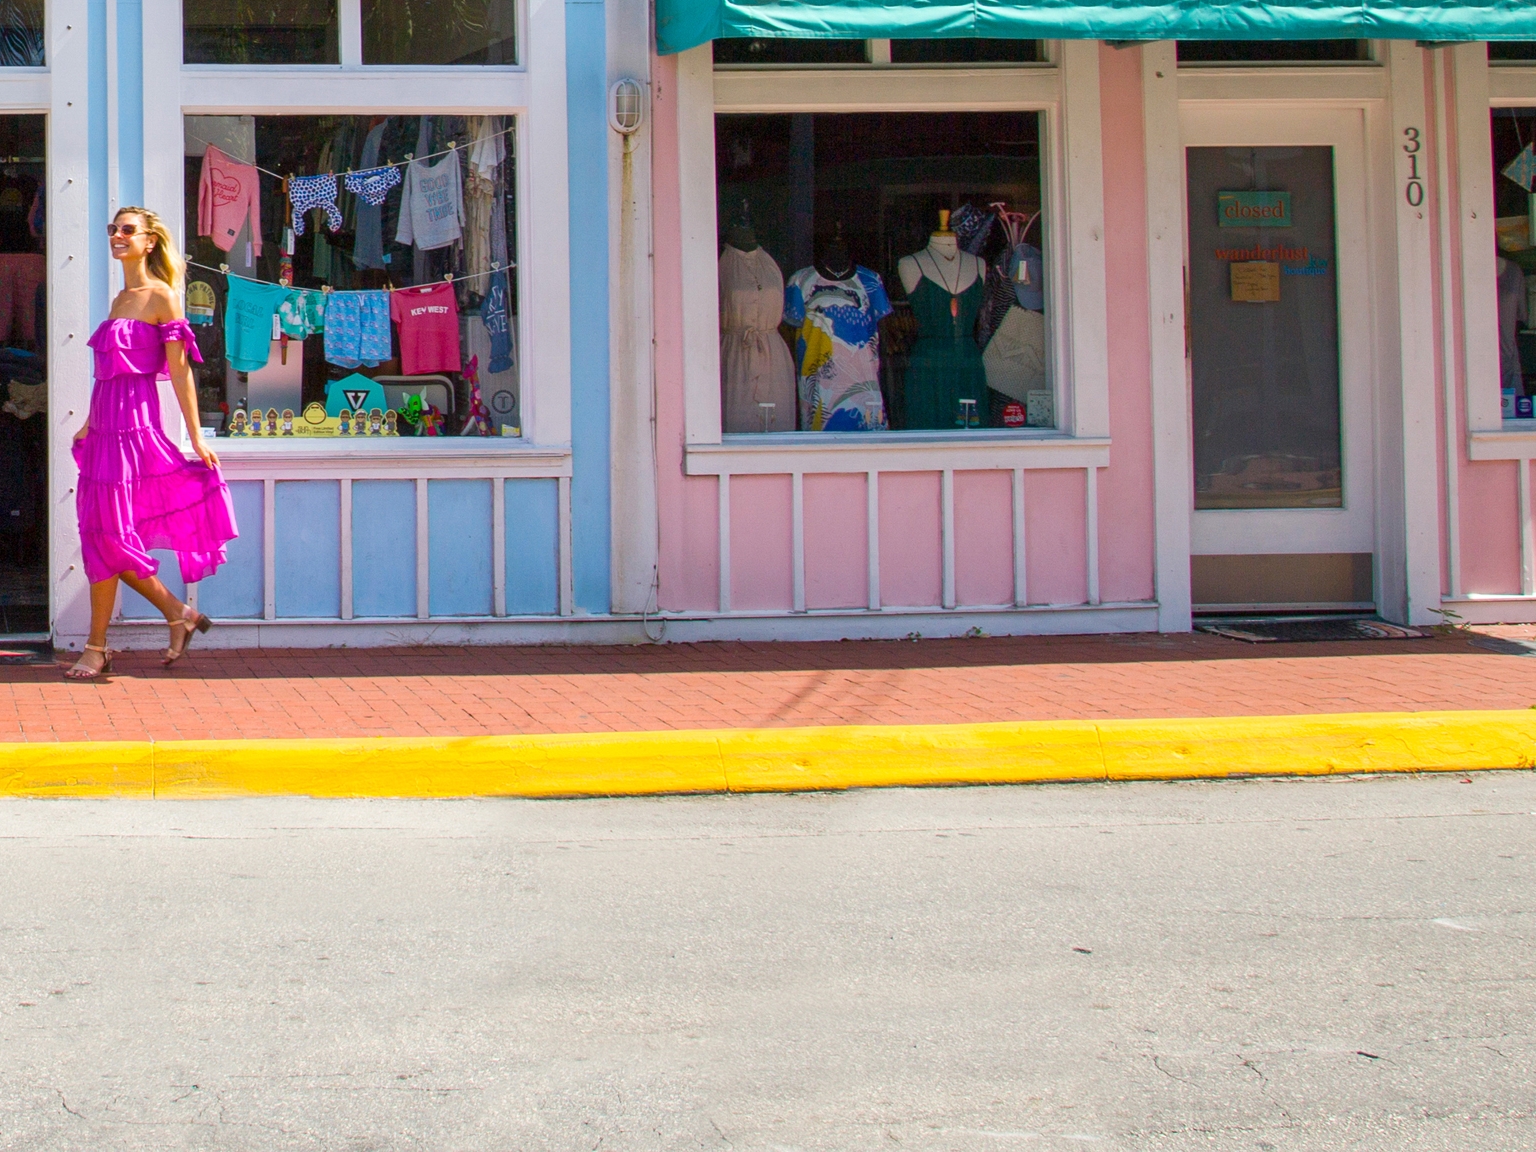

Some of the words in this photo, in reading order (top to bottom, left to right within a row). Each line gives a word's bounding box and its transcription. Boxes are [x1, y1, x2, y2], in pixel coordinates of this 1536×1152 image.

[1403, 127, 1424, 207] 310
[1225, 200, 1284, 219] closed
[1215, 244, 1308, 261] wanderlust
[410, 307, 427, 317] KEY
[428, 305, 450, 315] WEST
